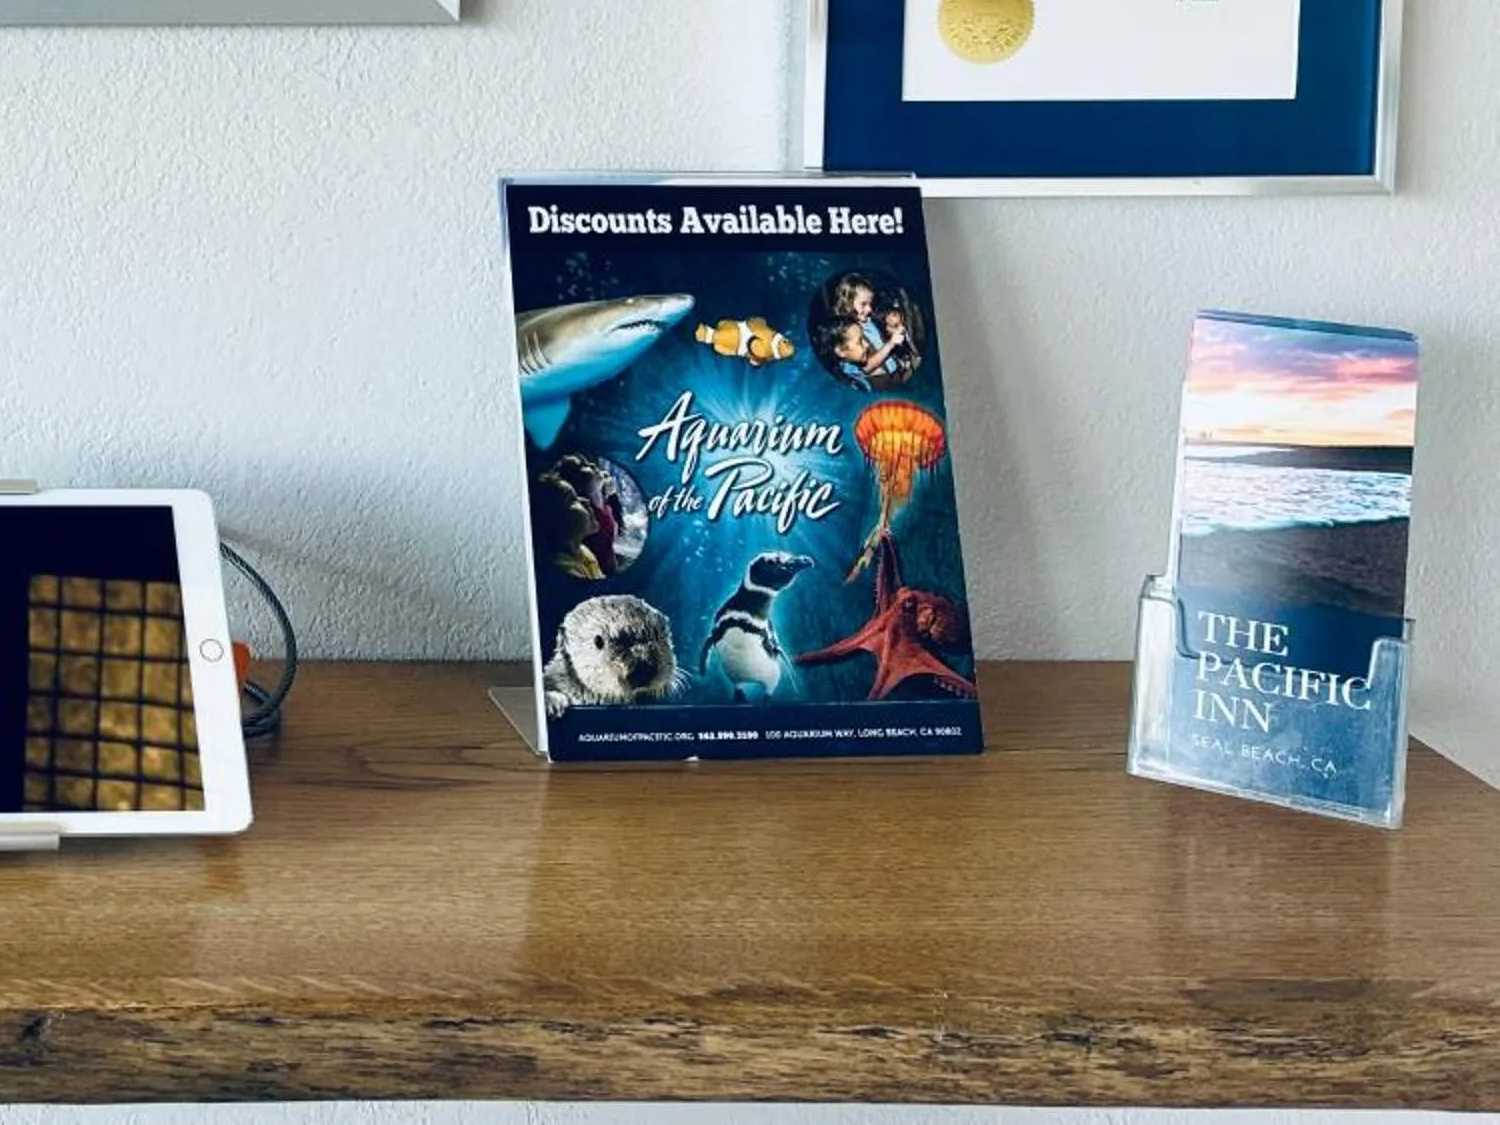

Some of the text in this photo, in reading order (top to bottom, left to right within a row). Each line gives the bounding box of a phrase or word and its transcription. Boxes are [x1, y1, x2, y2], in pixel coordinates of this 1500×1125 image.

[528, 204, 904, 235] Discounts Available Here!
[635, 390, 845, 485] Aquarium
[647, 484, 703, 520] of the
[703, 457, 842, 534] Pacific
[1197, 609, 1290, 657] THE
[1197, 649, 1372, 711] PACIFIC
[783, 729, 833, 740] AQUARIUM
[857, 728, 885, 738] LONG
[919, 727, 933, 737] CA
[1192, 687, 1270, 734] INN
[1191, 733, 1236, 756] SEAL
[1310, 756, 1338, 778] CA
